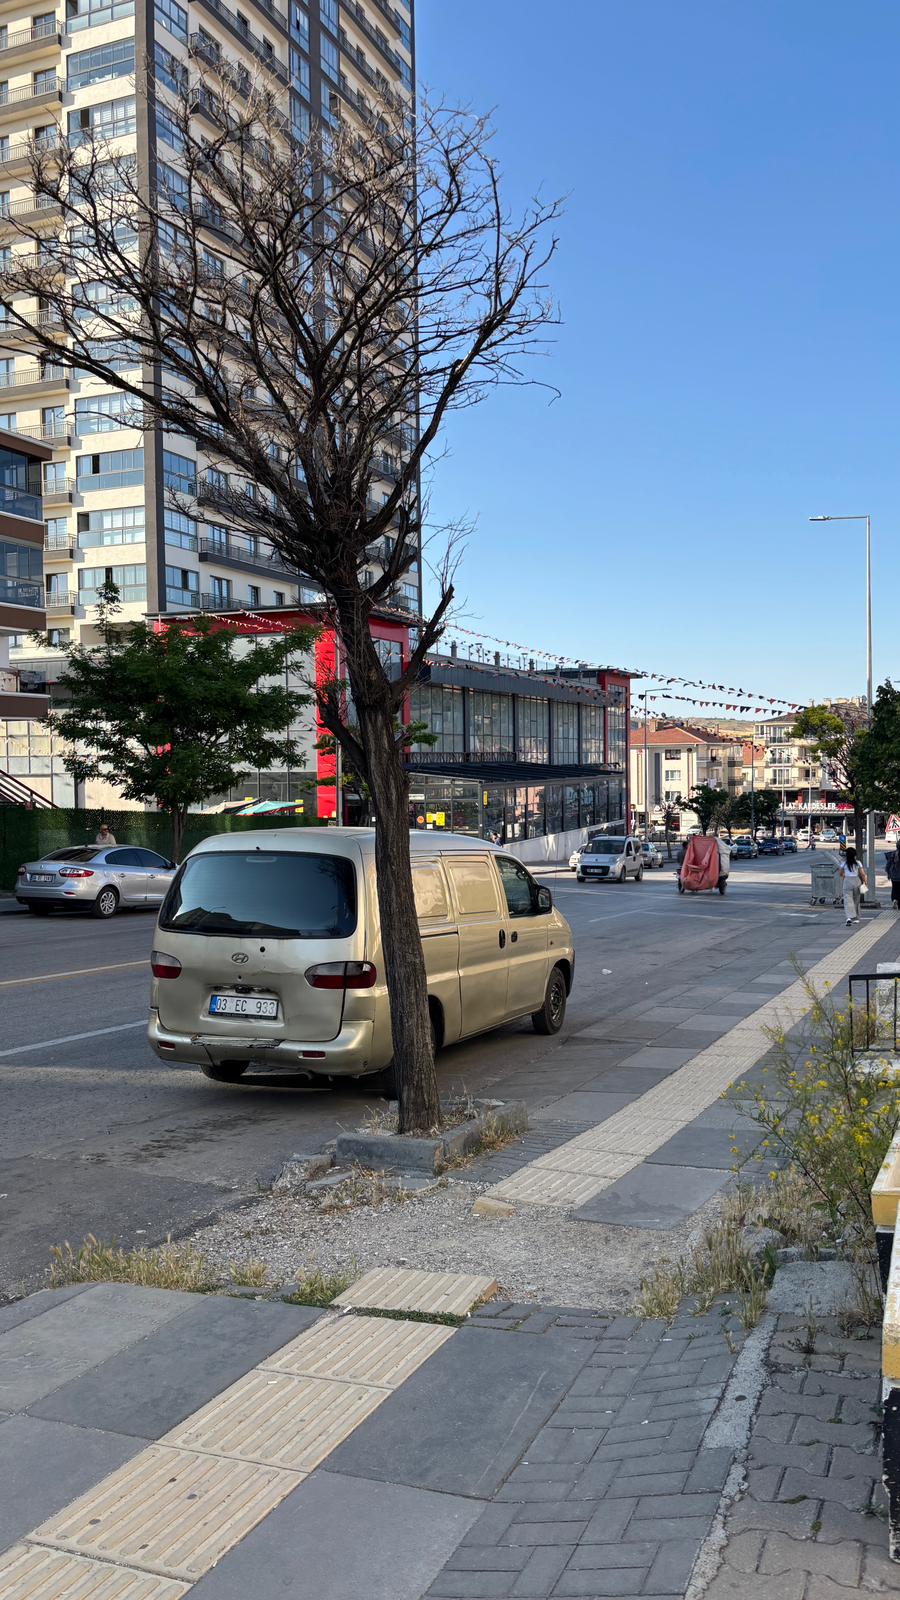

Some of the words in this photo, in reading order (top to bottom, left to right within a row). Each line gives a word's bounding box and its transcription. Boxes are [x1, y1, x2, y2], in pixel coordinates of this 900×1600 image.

[216, 998, 228, 1011] 03
[235, 1000, 247, 1012] EC
[255, 1001, 275, 1014] 933
